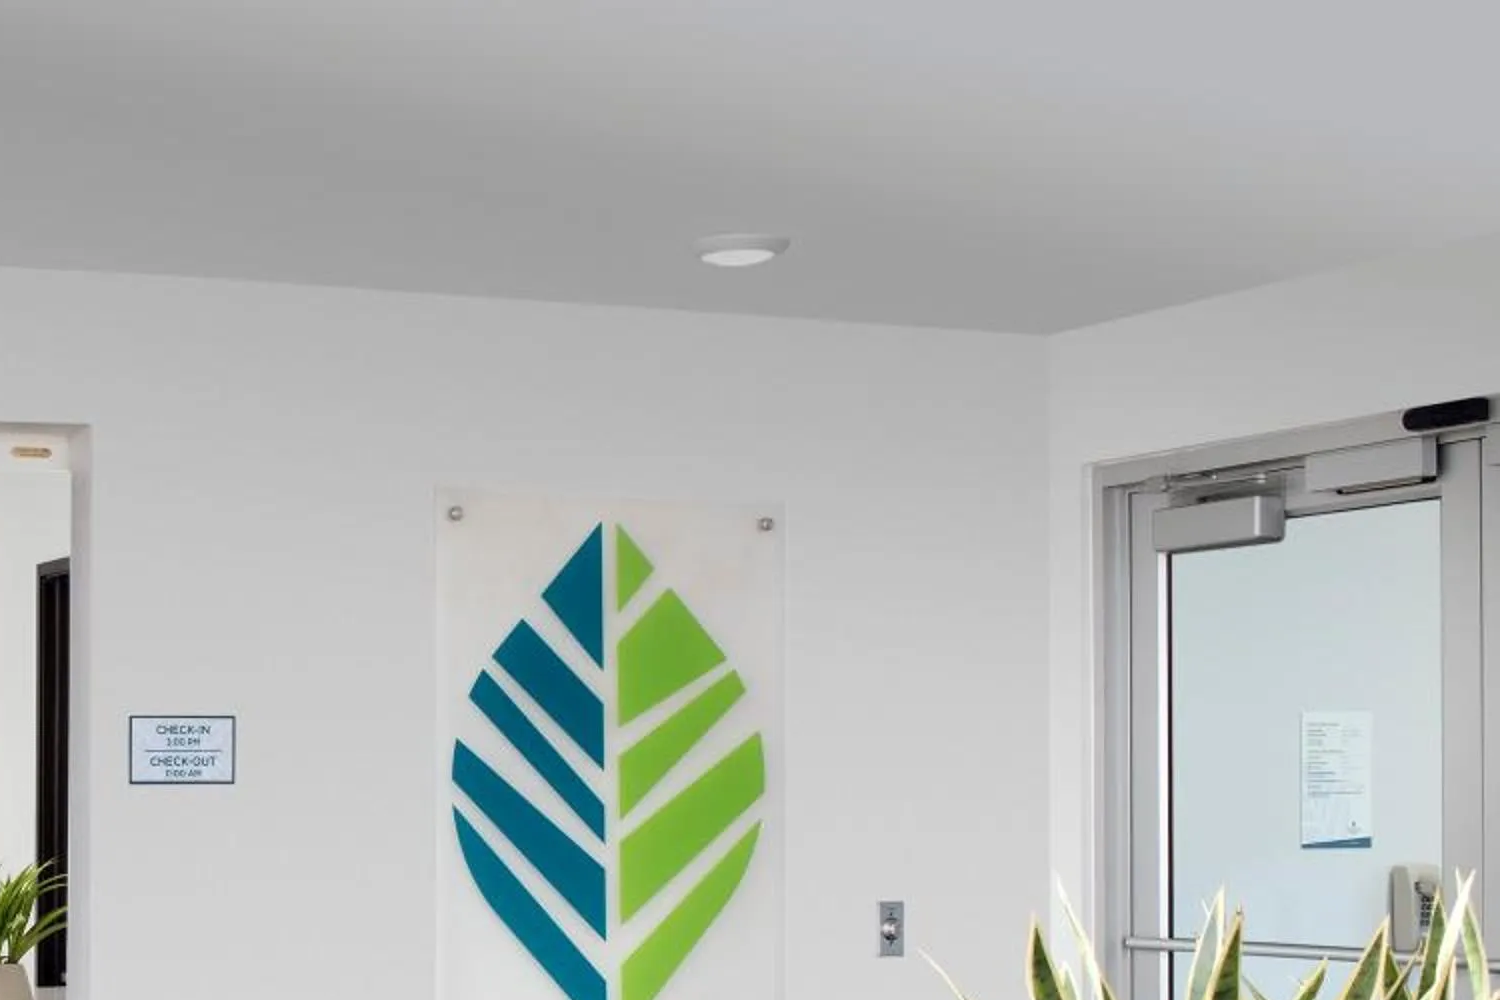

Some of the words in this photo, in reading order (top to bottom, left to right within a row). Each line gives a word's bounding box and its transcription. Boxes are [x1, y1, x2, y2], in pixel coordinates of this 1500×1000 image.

[156, 725, 211, 735] CHECK-IN
[187, 738, 201, 746] PM
[149, 756, 216, 767] CHECK-OUT
[187, 769, 202, 777] AM
